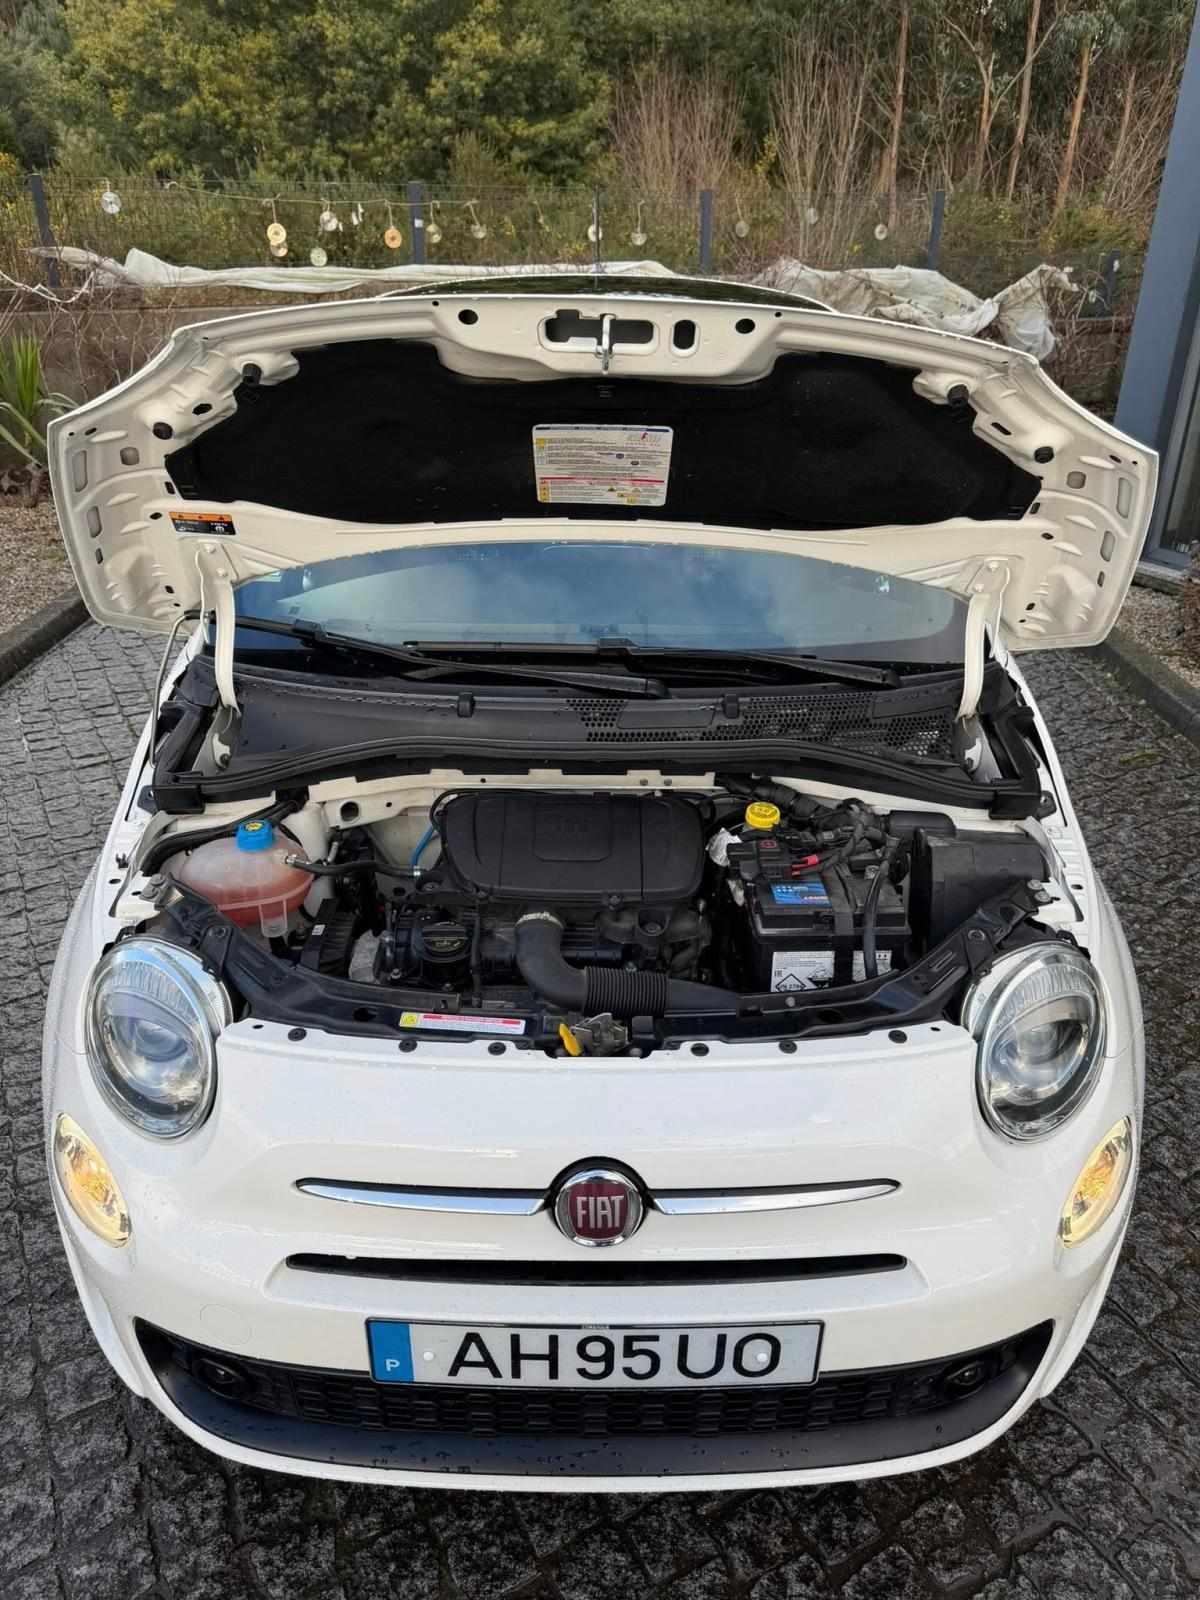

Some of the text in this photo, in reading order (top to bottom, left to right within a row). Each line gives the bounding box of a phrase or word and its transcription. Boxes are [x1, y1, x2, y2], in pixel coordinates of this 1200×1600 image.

[576, 1195, 625, 1229] FIAT
[385, 1358, 401, 1372] P
[447, 1332, 560, 1380] AH
[575, 1334, 661, 1381] 95
